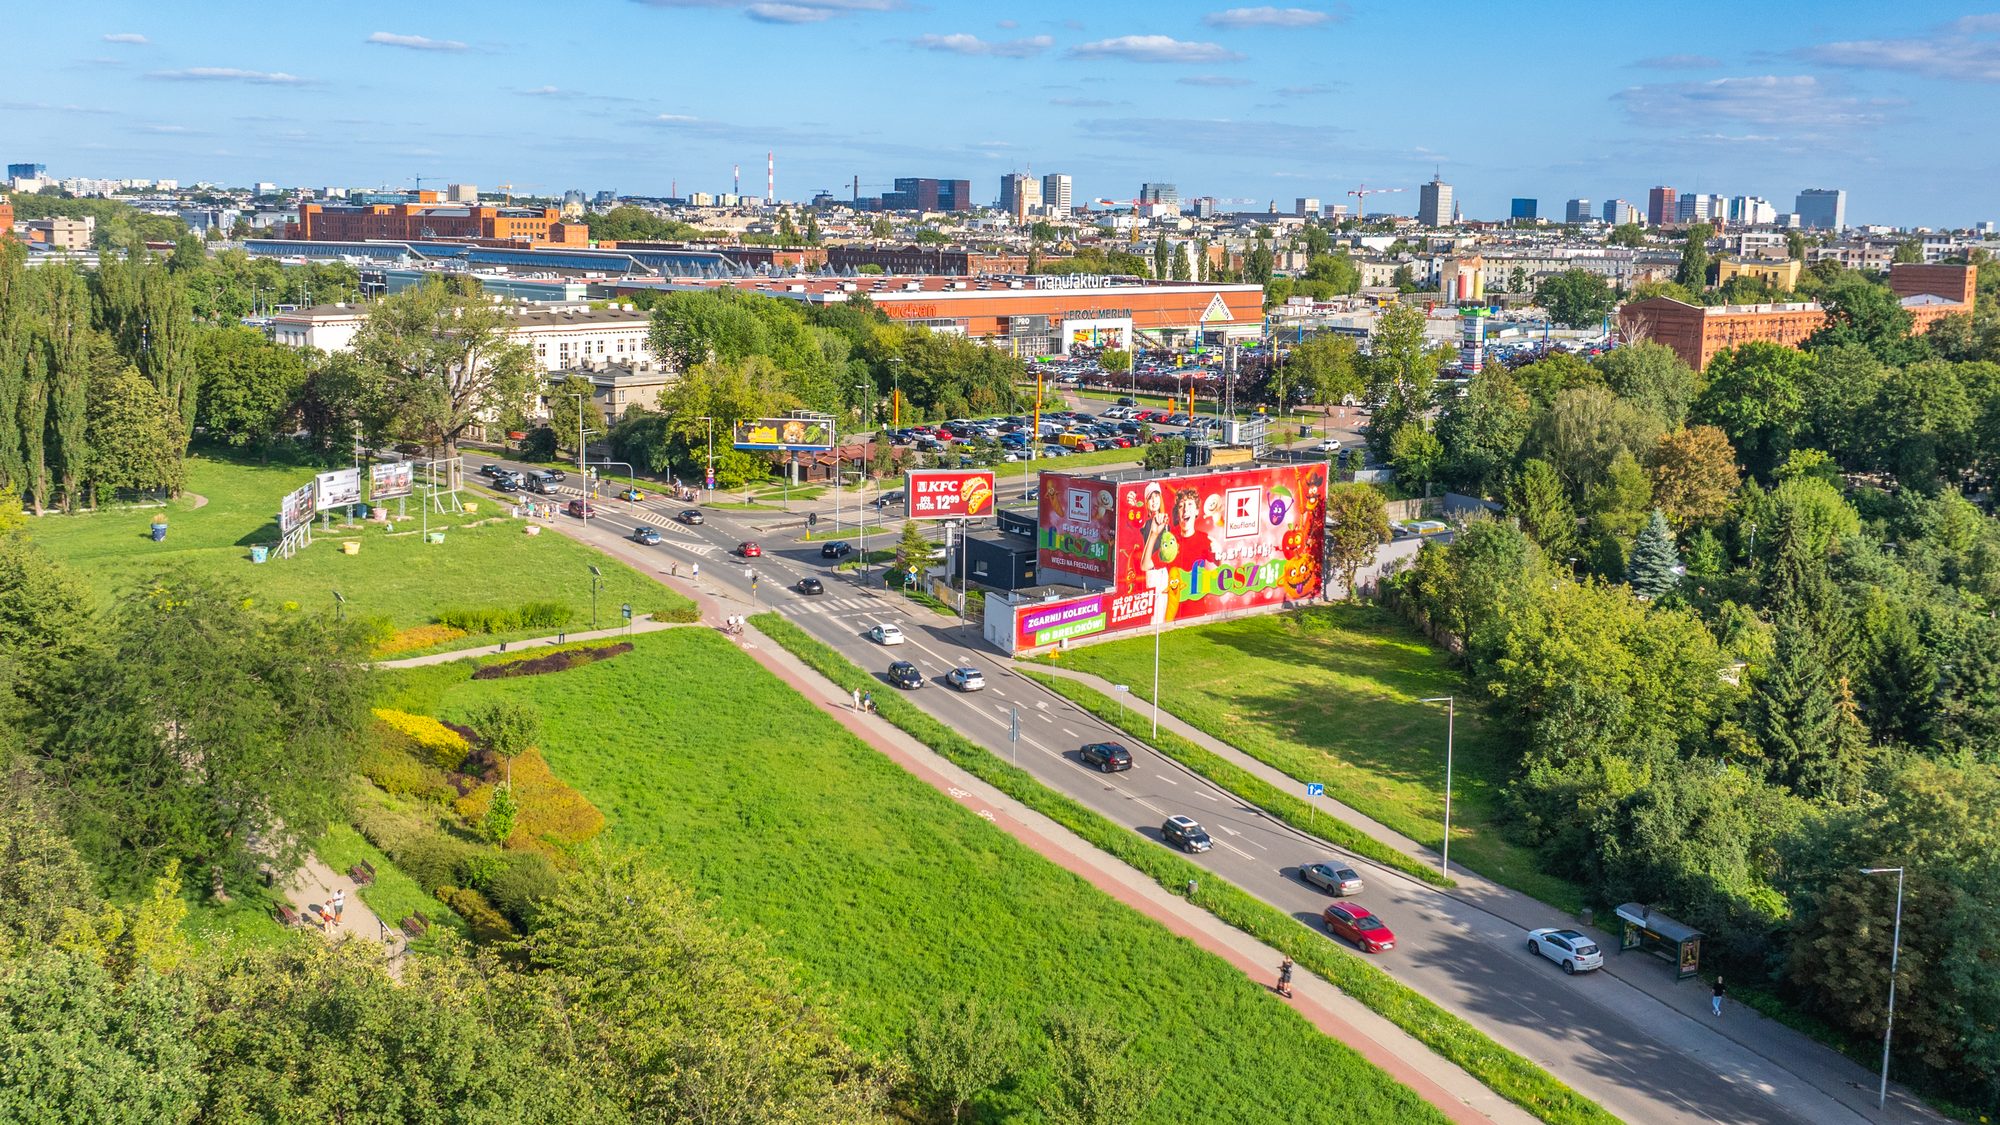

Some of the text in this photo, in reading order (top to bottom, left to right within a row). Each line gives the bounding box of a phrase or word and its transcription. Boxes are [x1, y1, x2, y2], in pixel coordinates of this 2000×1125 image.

[1035, 272, 1111, 290] manufaktura
[1064, 308, 1132, 320] LEROY MERLIN
[928, 481, 958, 492] KFC
[1229, 521, 1256, 530] Kaufland
[1048, 526, 1104, 557] freszaki
[1189, 559, 1280, 595] freszaki
[1113, 597, 1124, 606] JUŻ
[1124, 595, 1133, 603] OD
[1028, 602, 1099, 628] ZGARNIJ KOLEKCJĘ
[1040, 619, 1103, 642] 10 BRELOKÓW!
